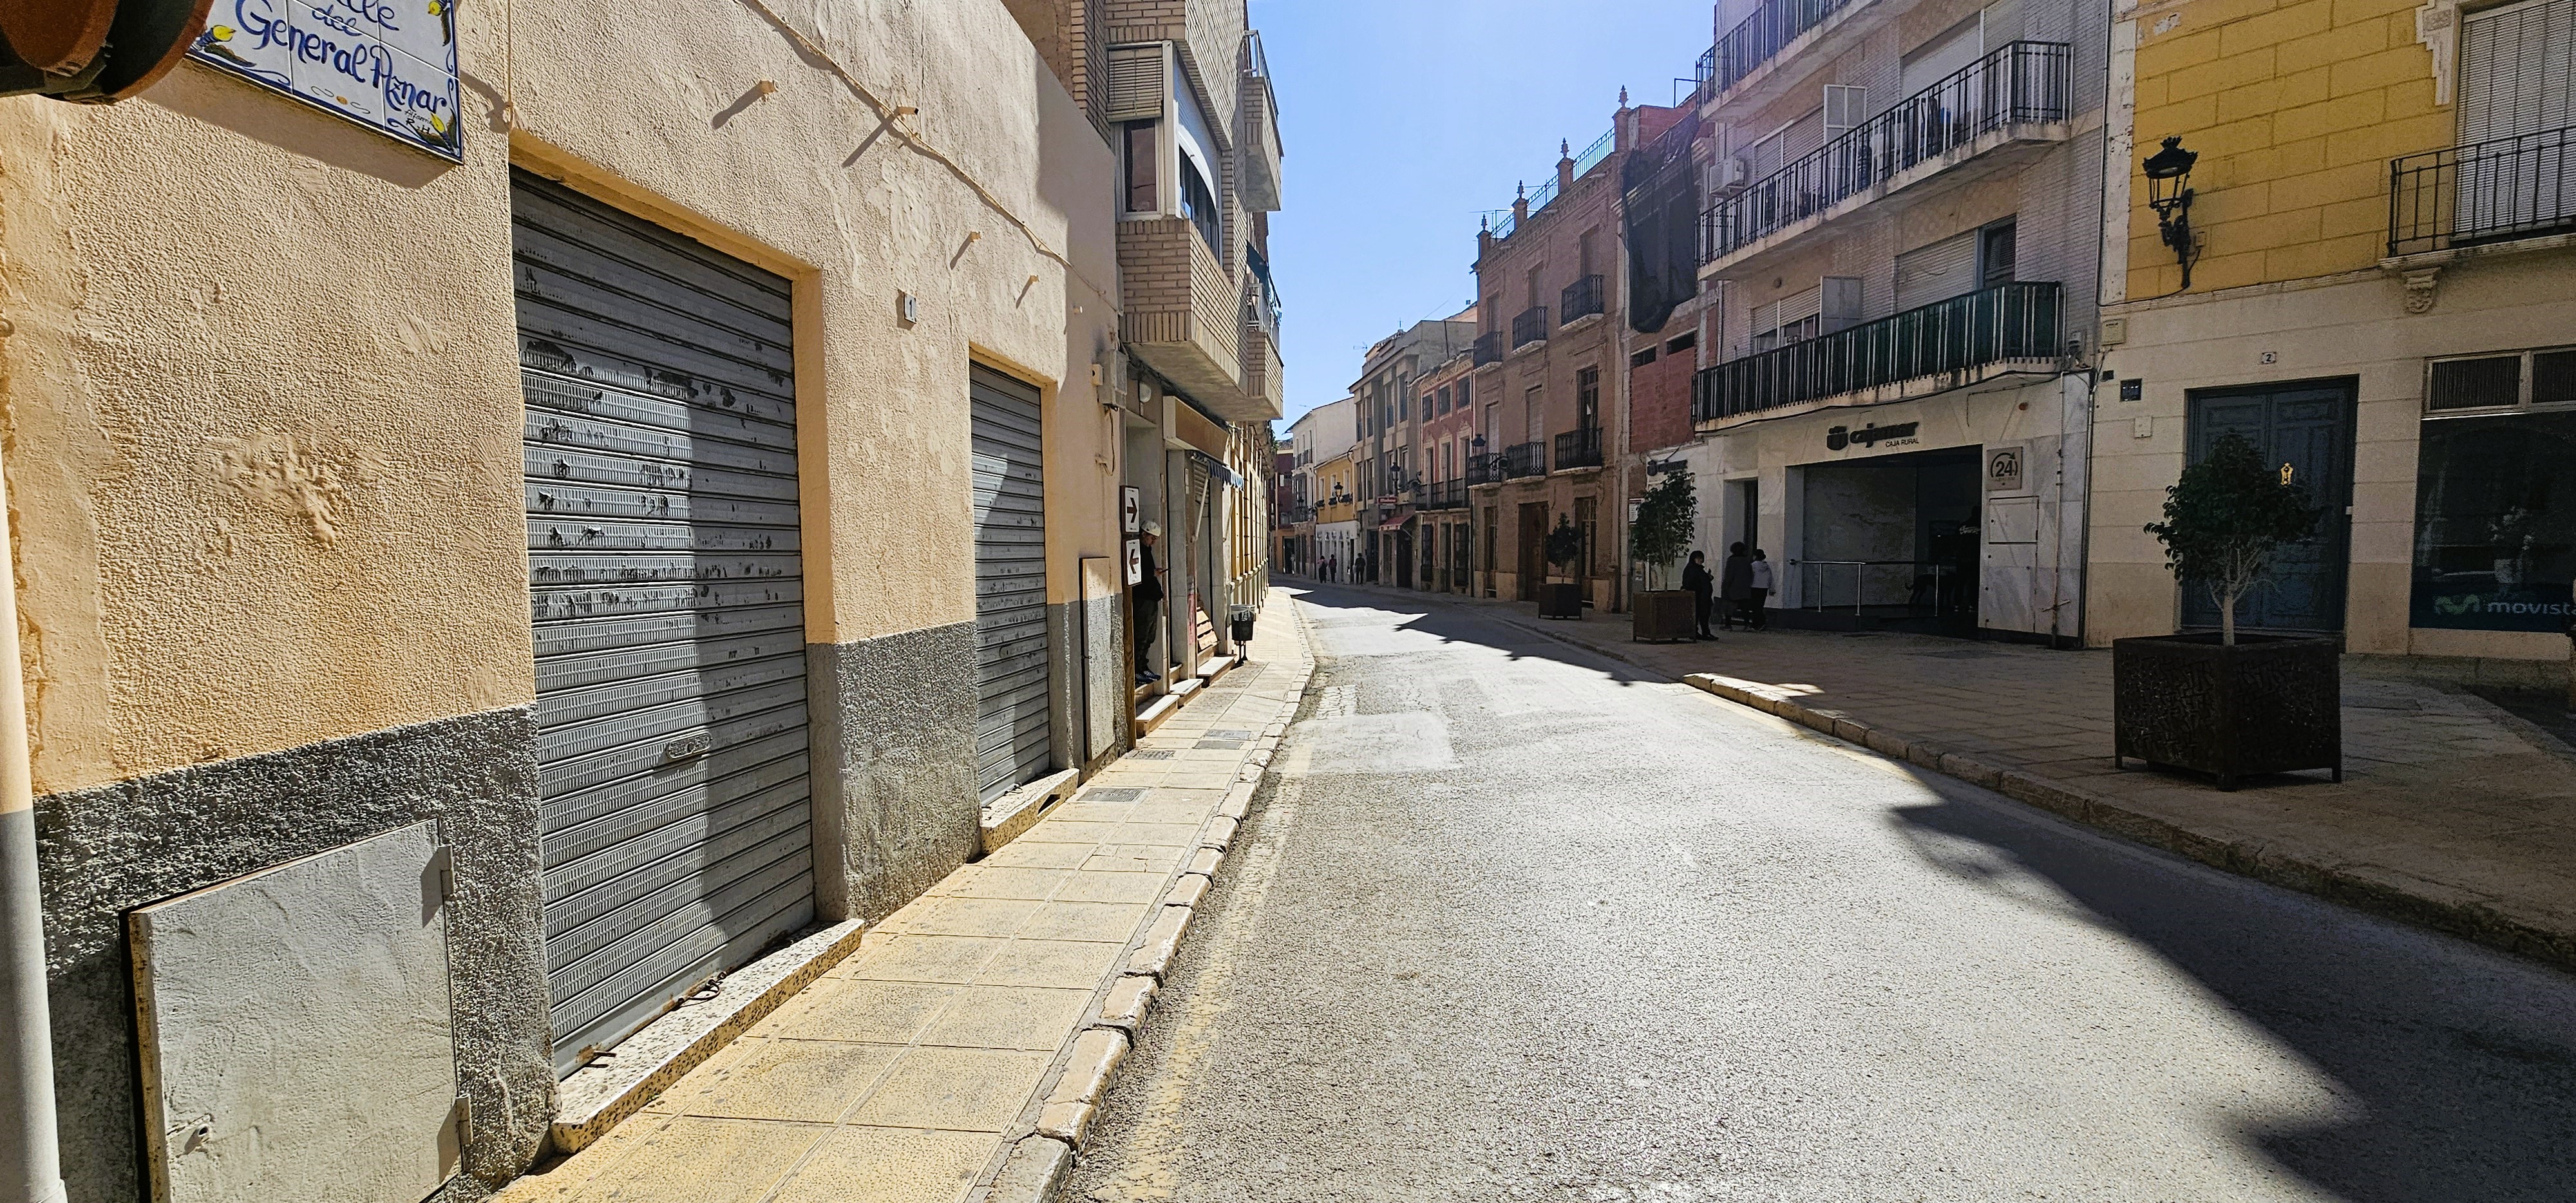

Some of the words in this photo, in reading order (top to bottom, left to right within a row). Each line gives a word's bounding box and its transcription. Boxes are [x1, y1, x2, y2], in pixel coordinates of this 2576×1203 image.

[312, 4, 363, 37] del
[235, 0, 366, 84] General
[370, 44, 448, 115] Aznar
[909, 299, 913, 317] 1
[2266, 354, 2272, 362] 2
[1995, 459, 2012, 477] 24
[2486, 601, 2576, 616] movist
